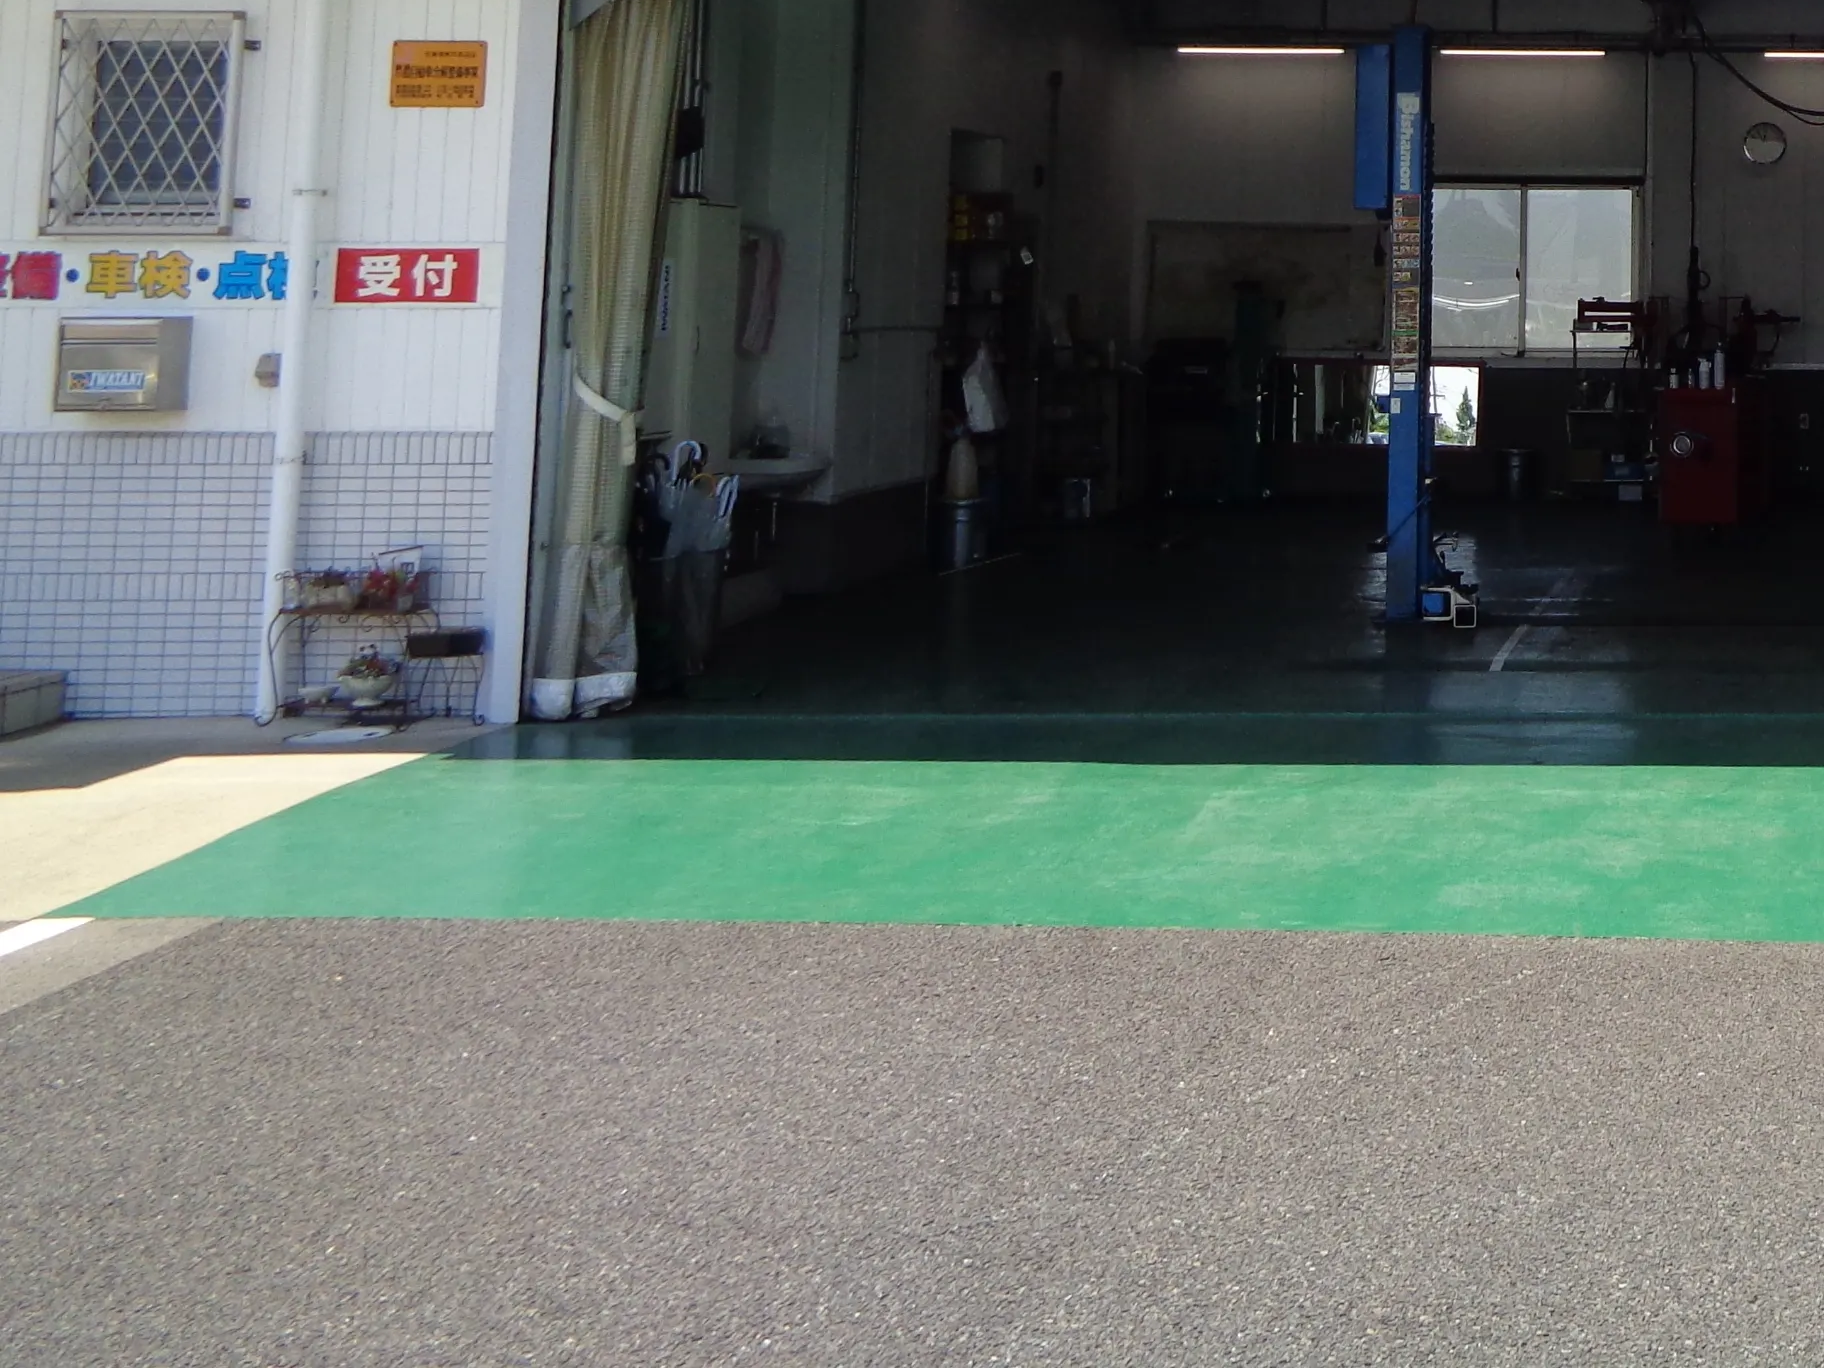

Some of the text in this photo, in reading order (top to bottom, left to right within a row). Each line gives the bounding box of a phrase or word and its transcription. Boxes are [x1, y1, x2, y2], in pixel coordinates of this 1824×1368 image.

[1397, 92, 1420, 191] Bishamon
[356, 255, 458, 298] 受付
[88, 371, 145, 387] IWATANI
